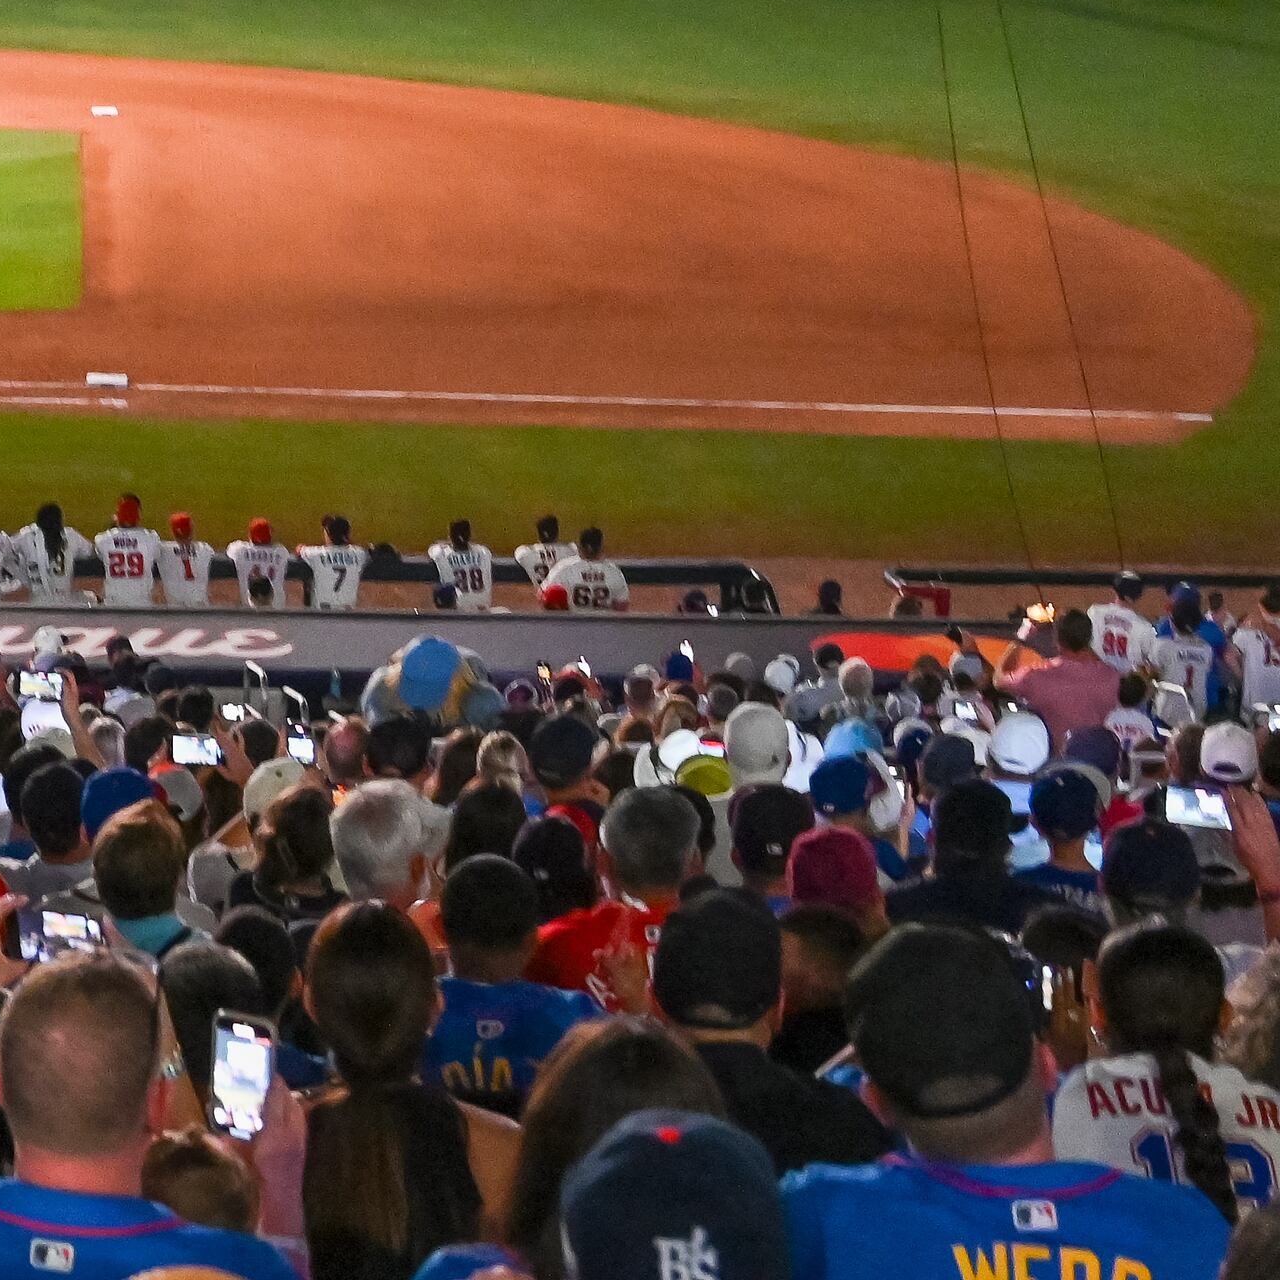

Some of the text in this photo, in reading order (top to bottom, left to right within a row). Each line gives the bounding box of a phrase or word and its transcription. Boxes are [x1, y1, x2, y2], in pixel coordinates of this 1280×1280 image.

[108, 551, 145, 578] 29
[332, 565, 348, 593] 7
[1086, 1077, 1214, 1120] ACU
